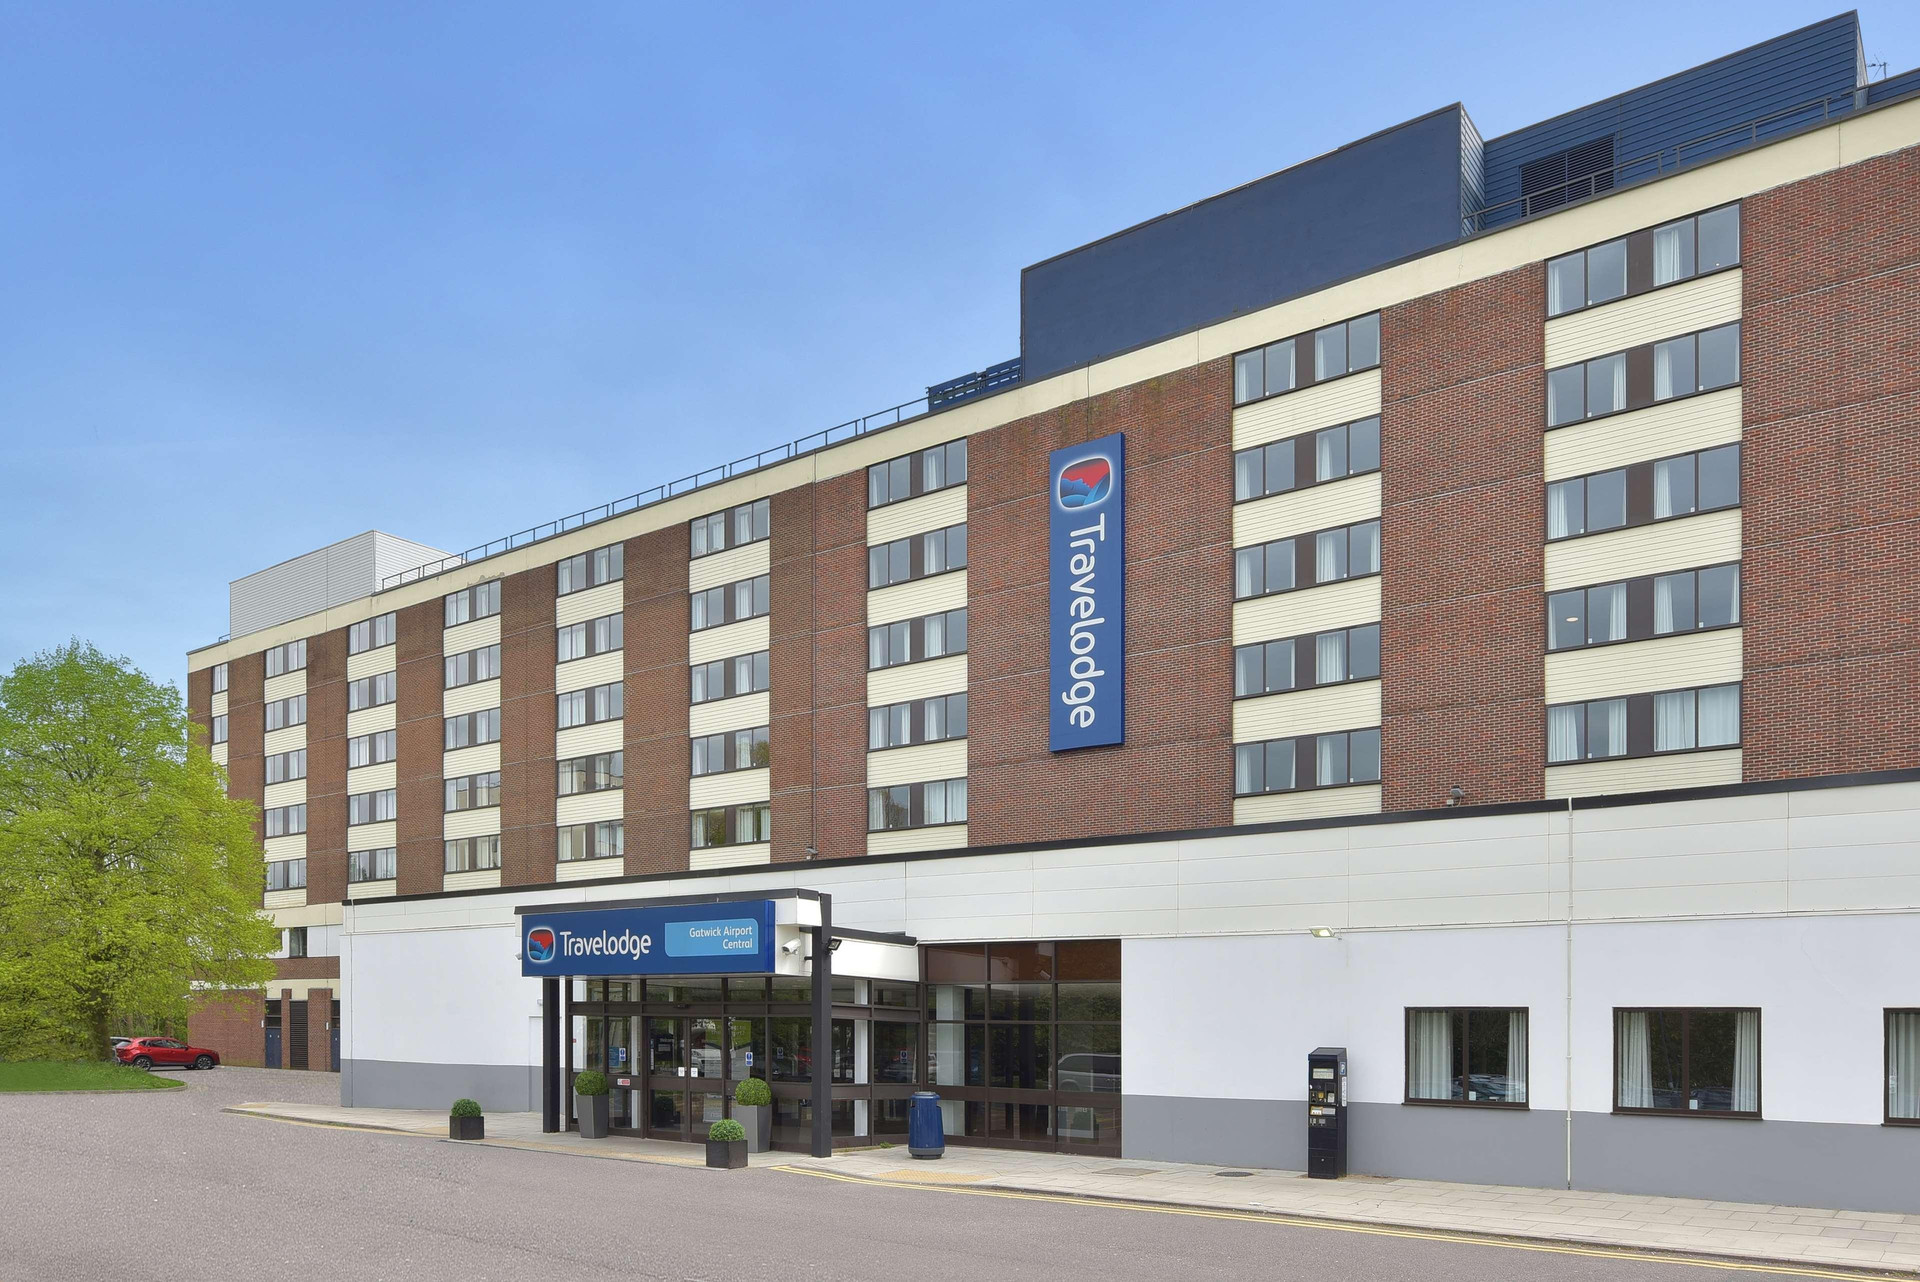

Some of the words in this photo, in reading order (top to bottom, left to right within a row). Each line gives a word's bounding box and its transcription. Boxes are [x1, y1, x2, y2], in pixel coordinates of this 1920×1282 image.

[1062, 513, 1105, 728] Travelodge
[689, 926, 722, 938] Gatwick
[723, 926, 752, 938] Airport
[560, 928, 652, 960] Travelodge
[722, 938, 753, 949] Central
